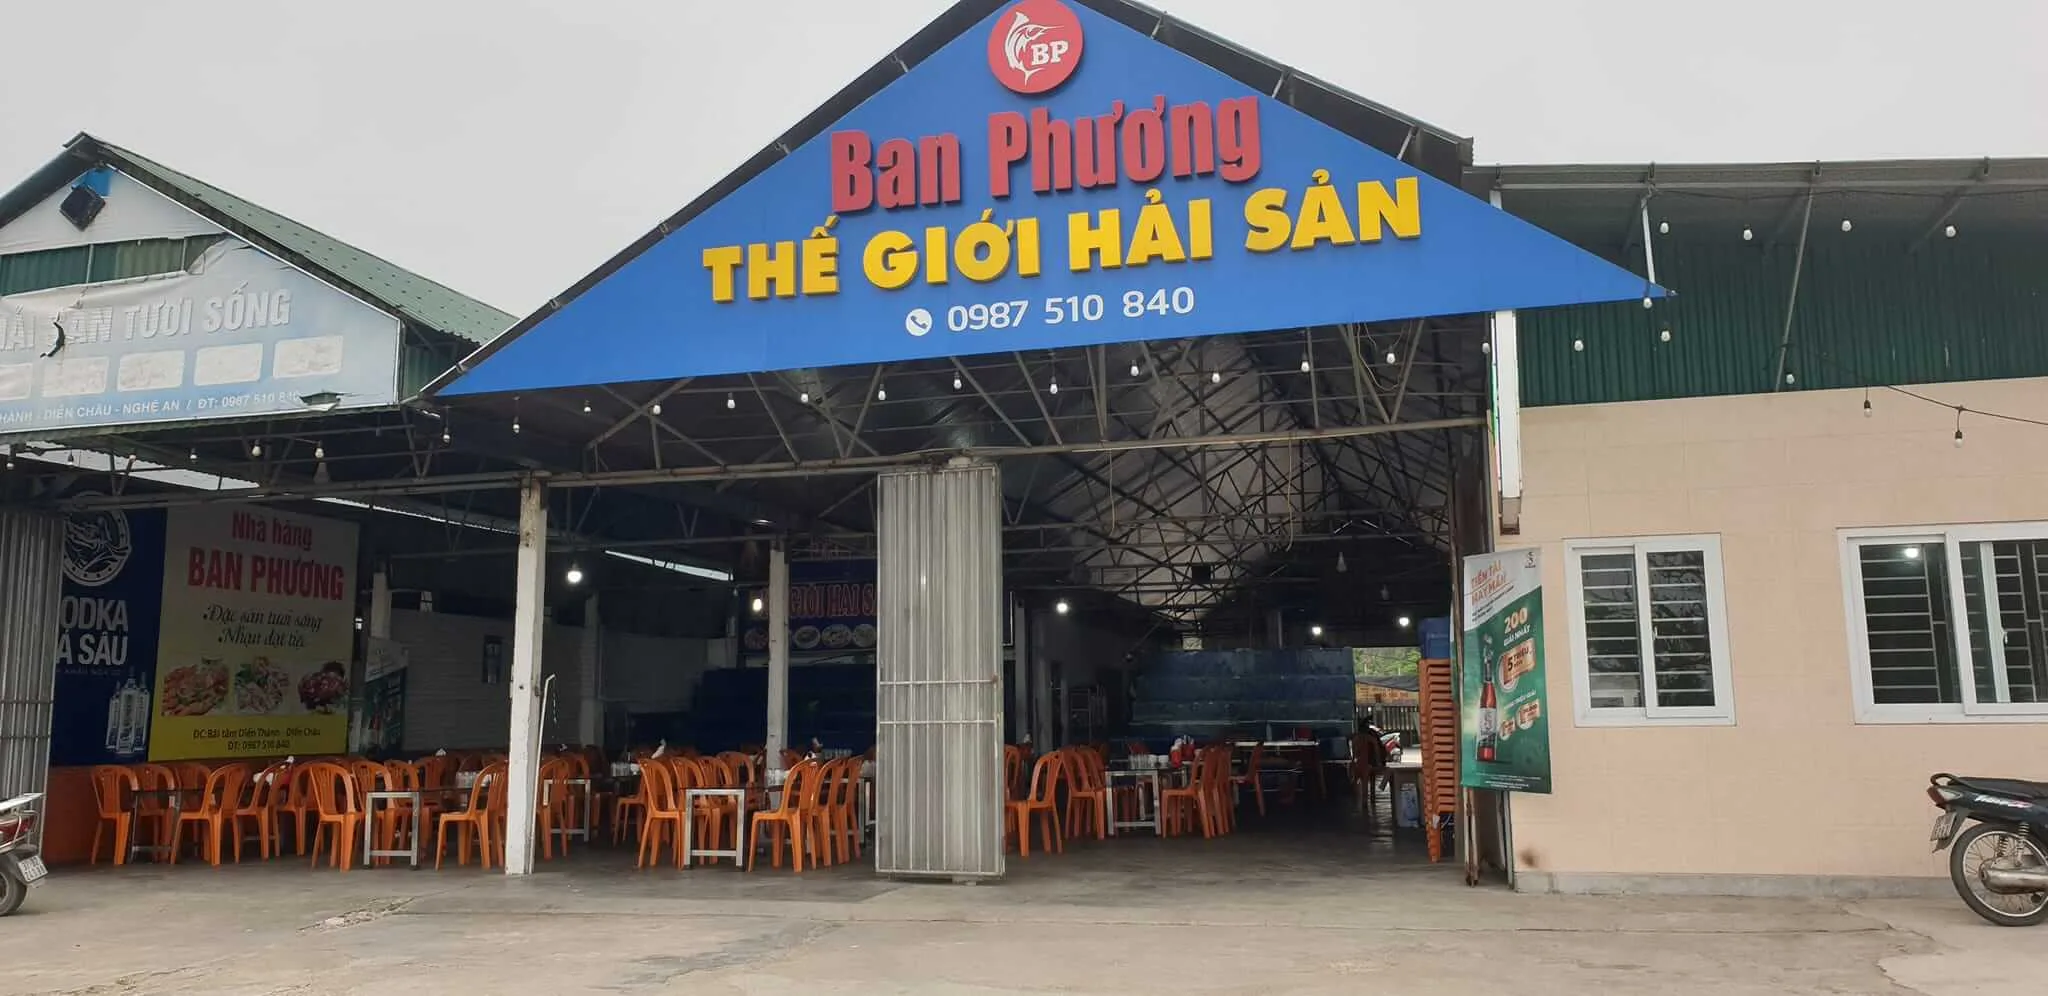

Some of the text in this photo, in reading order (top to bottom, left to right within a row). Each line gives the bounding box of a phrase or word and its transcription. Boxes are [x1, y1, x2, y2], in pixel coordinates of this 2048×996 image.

[1031, 40, 1069, 66] BP
[830, 94, 1262, 213] Ban Phương
[703, 168, 1421, 304] THẾ GIỚI HẢI SẢN
[125, 297, 193, 341] TƯƠI
[203, 281, 291, 334] SỐNG
[946, 286, 1194, 332] 0987 510 840
[162, 400, 180, 411] AN
[231, 510, 313, 551] Nhà hàng
[187, 546, 345, 601] BAN PHƯƠNG
[1504, 607, 1529, 634] 200
[1507, 656, 1513, 672] 5
